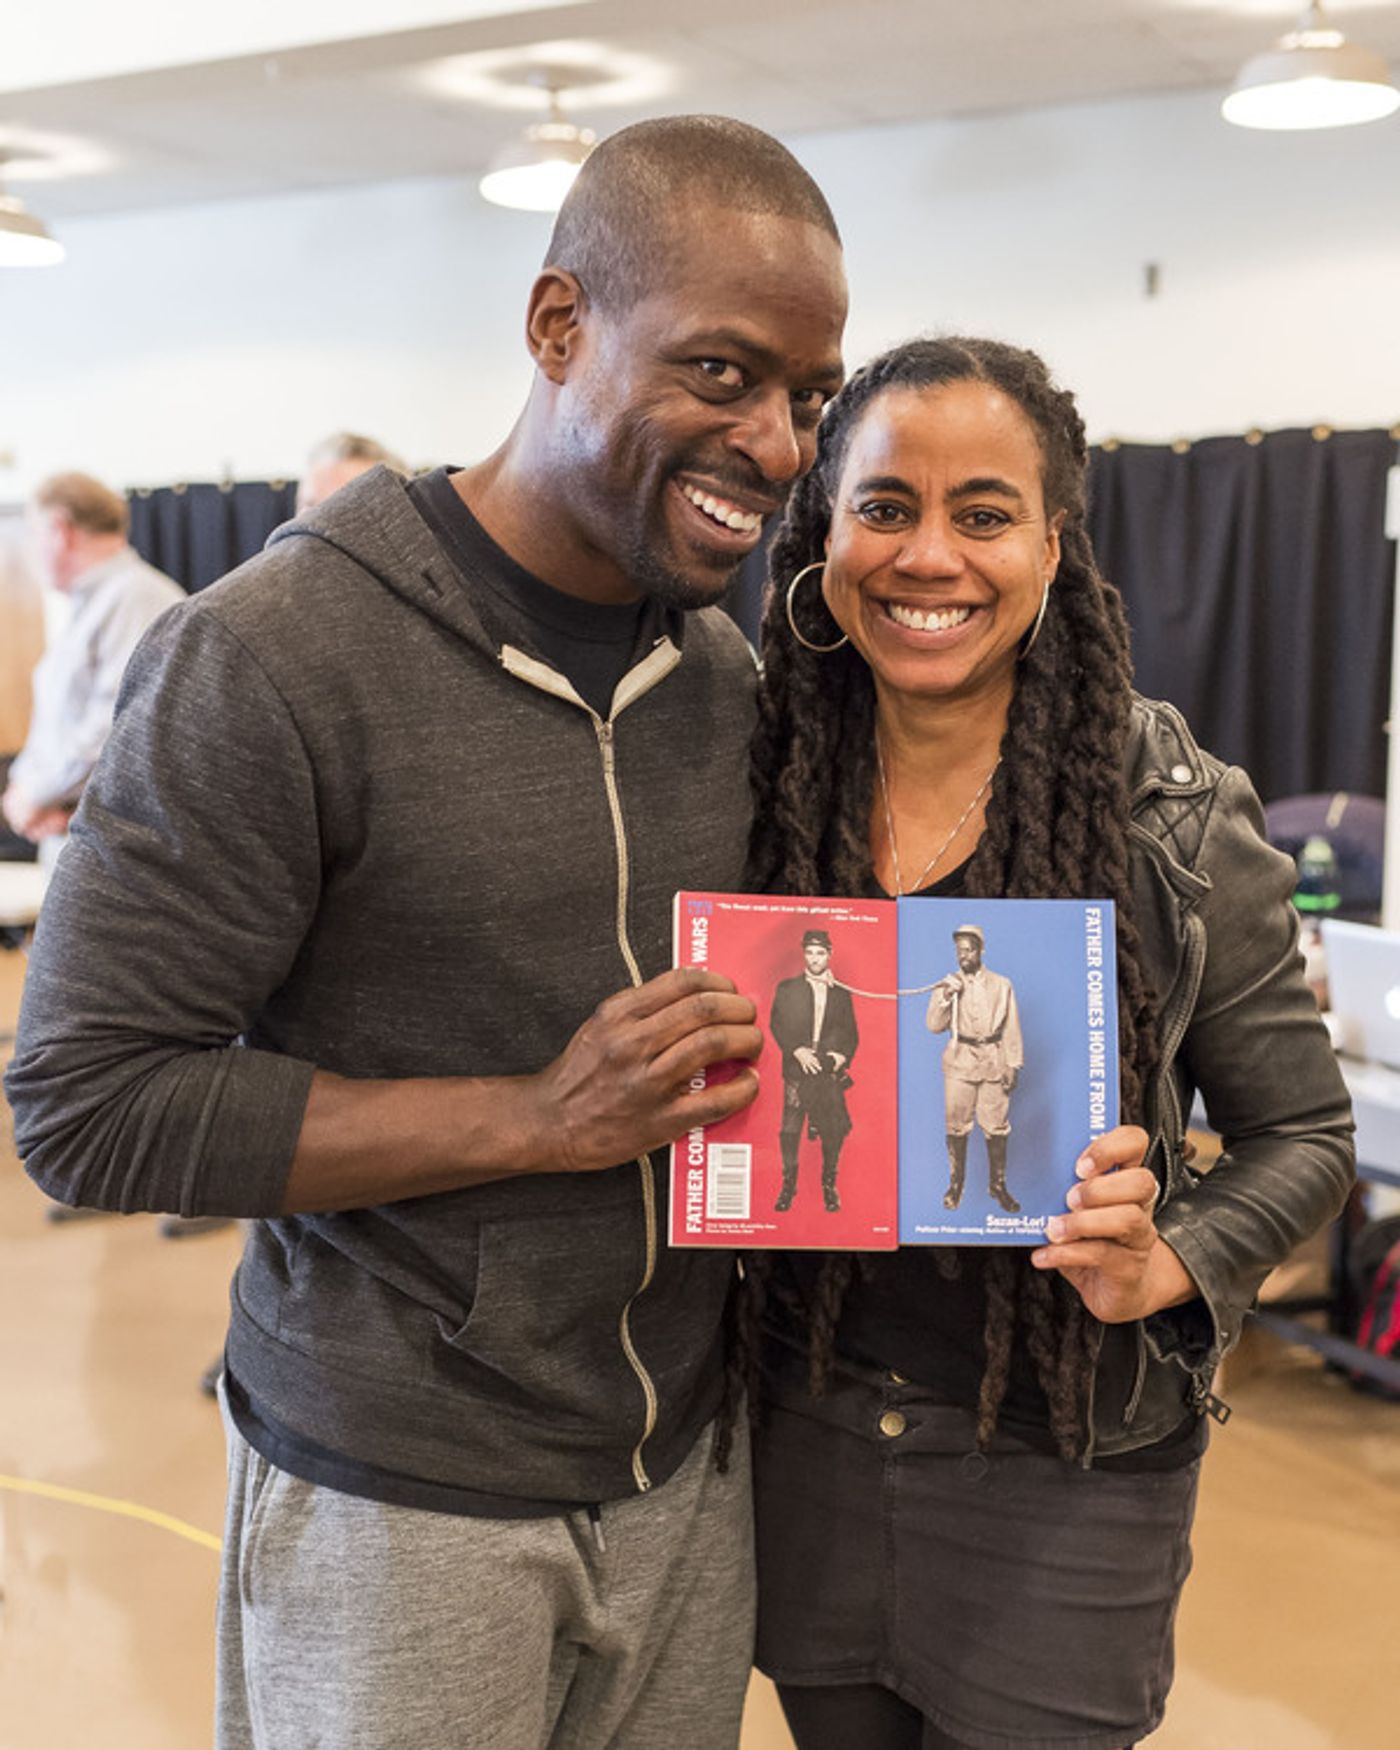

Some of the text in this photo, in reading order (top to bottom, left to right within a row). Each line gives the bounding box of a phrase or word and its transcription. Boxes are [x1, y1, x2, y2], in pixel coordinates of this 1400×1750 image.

[691, 917, 708, 963] WARS
[1085, 907, 1103, 967] FATHER
[1087, 970, 1105, 1028] COMES
[1088, 1030, 1106, 1079] HOME
[1089, 1081, 1106, 1130] FROM
[688, 1126, 705, 1166] COM
[686, 1169, 704, 1234] FATHER
[986, 1214, 1045, 1228] Suzan-Lori
